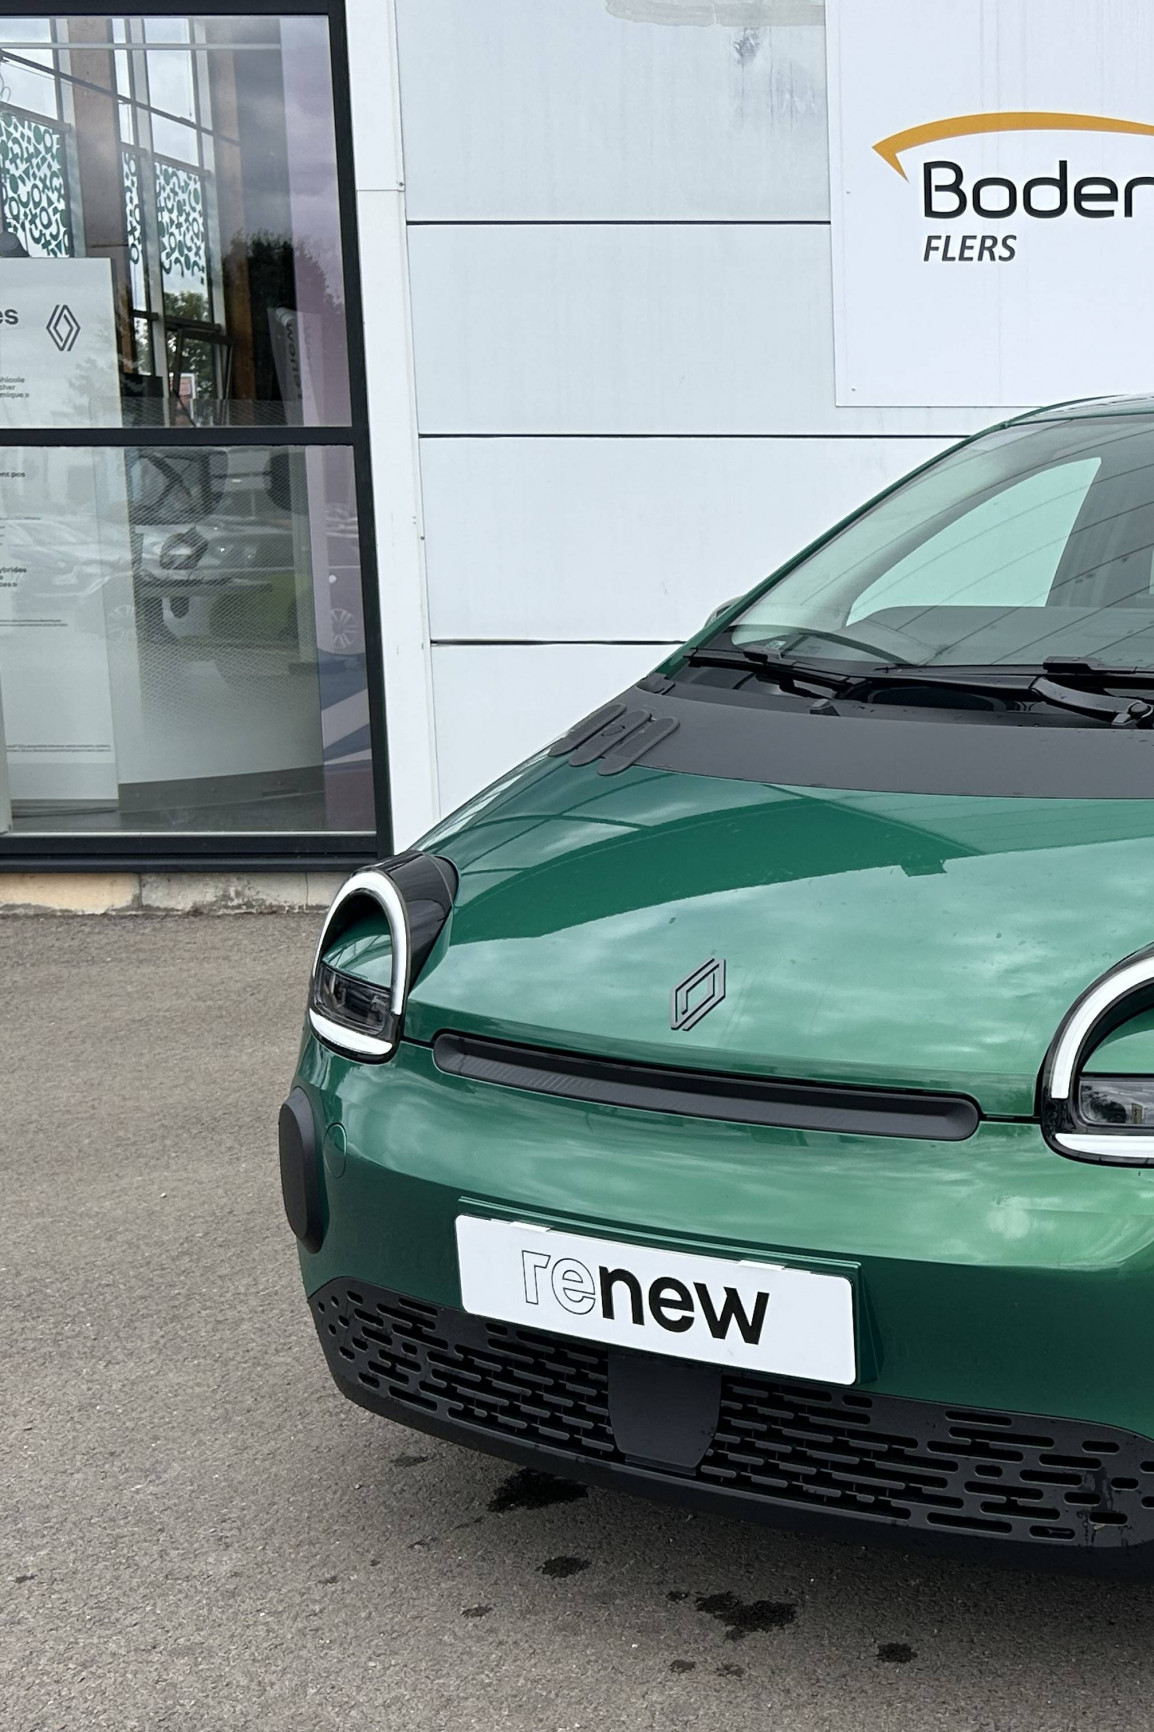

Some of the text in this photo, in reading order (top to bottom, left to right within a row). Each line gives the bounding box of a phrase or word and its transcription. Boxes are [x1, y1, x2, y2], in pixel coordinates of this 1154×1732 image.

[923, 234, 1017, 262] FLERS
[0, 308, 19, 325] s
[521, 1250, 770, 1345] renew
